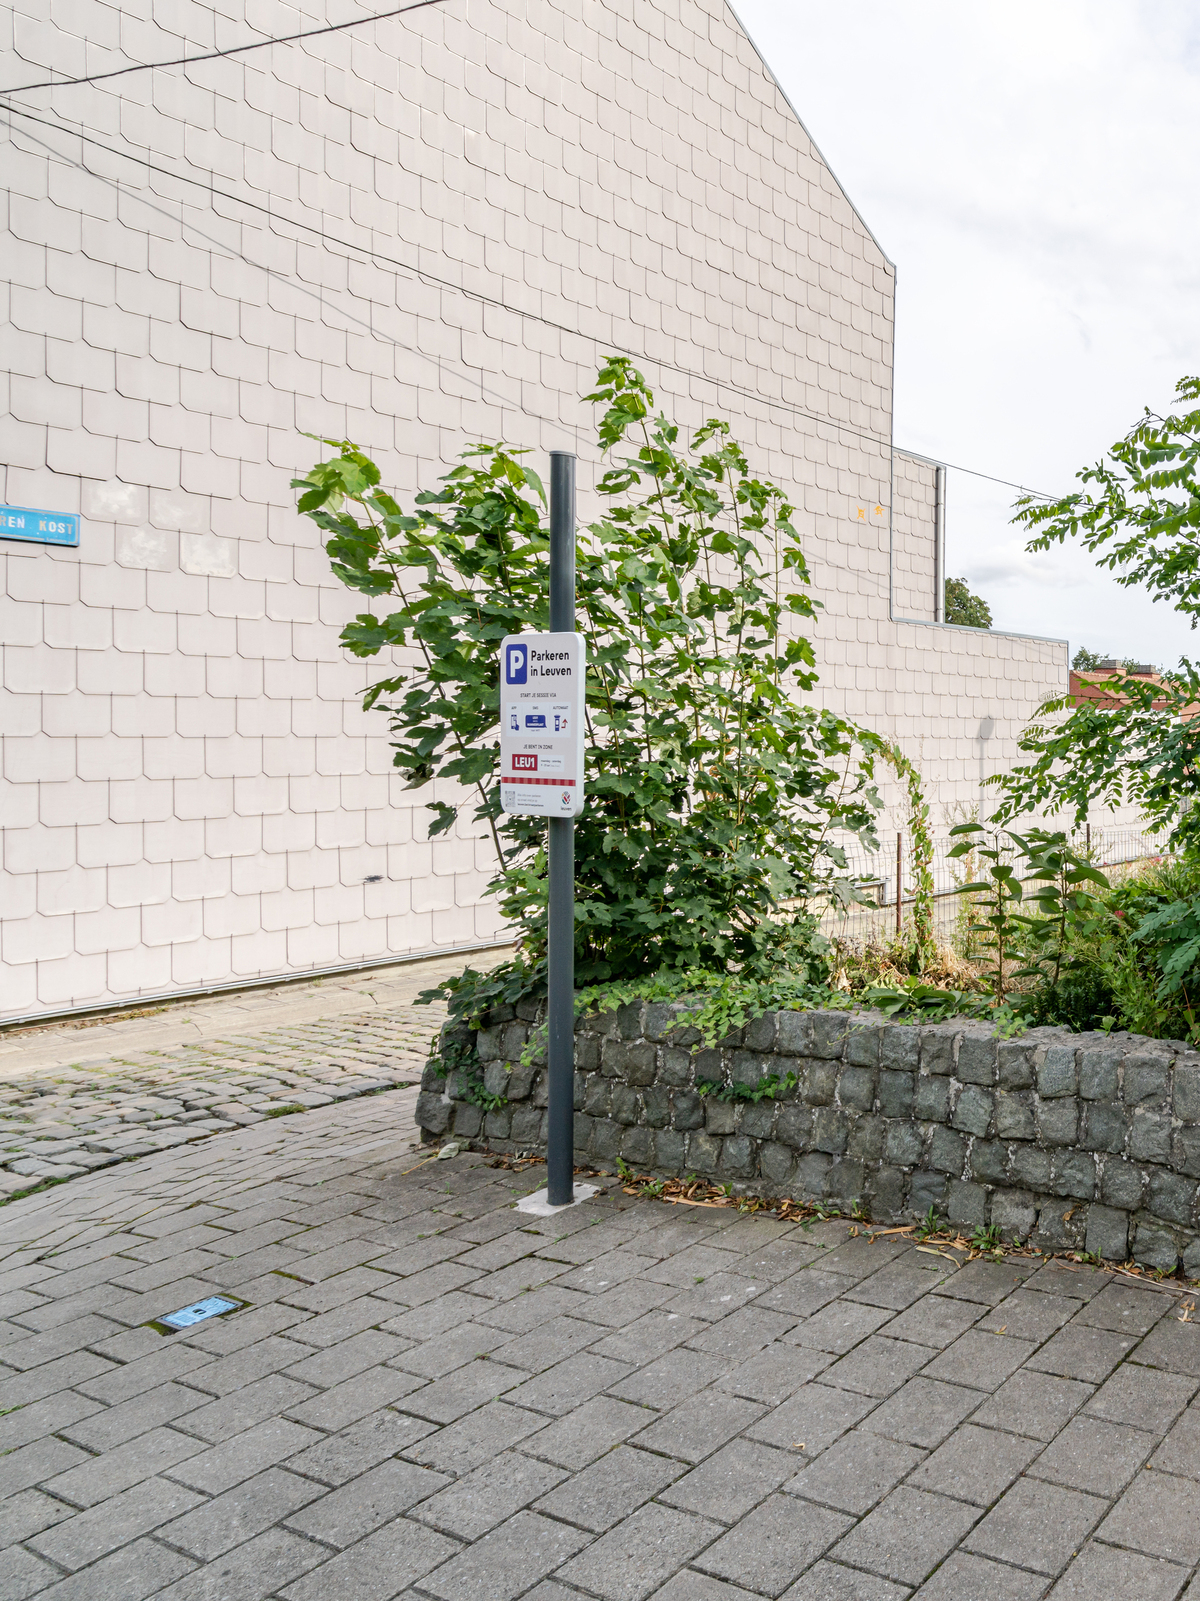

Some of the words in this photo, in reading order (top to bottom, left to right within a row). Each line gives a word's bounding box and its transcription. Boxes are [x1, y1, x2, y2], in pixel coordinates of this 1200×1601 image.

[39, 520, 73, 535] KOST
[531, 650, 569, 661] Parkeren
[510, 650, 524, 678] P
[530, 665, 538, 676] in
[540, 665, 572, 676] Leuven
[515, 756, 535, 768] LEU1
